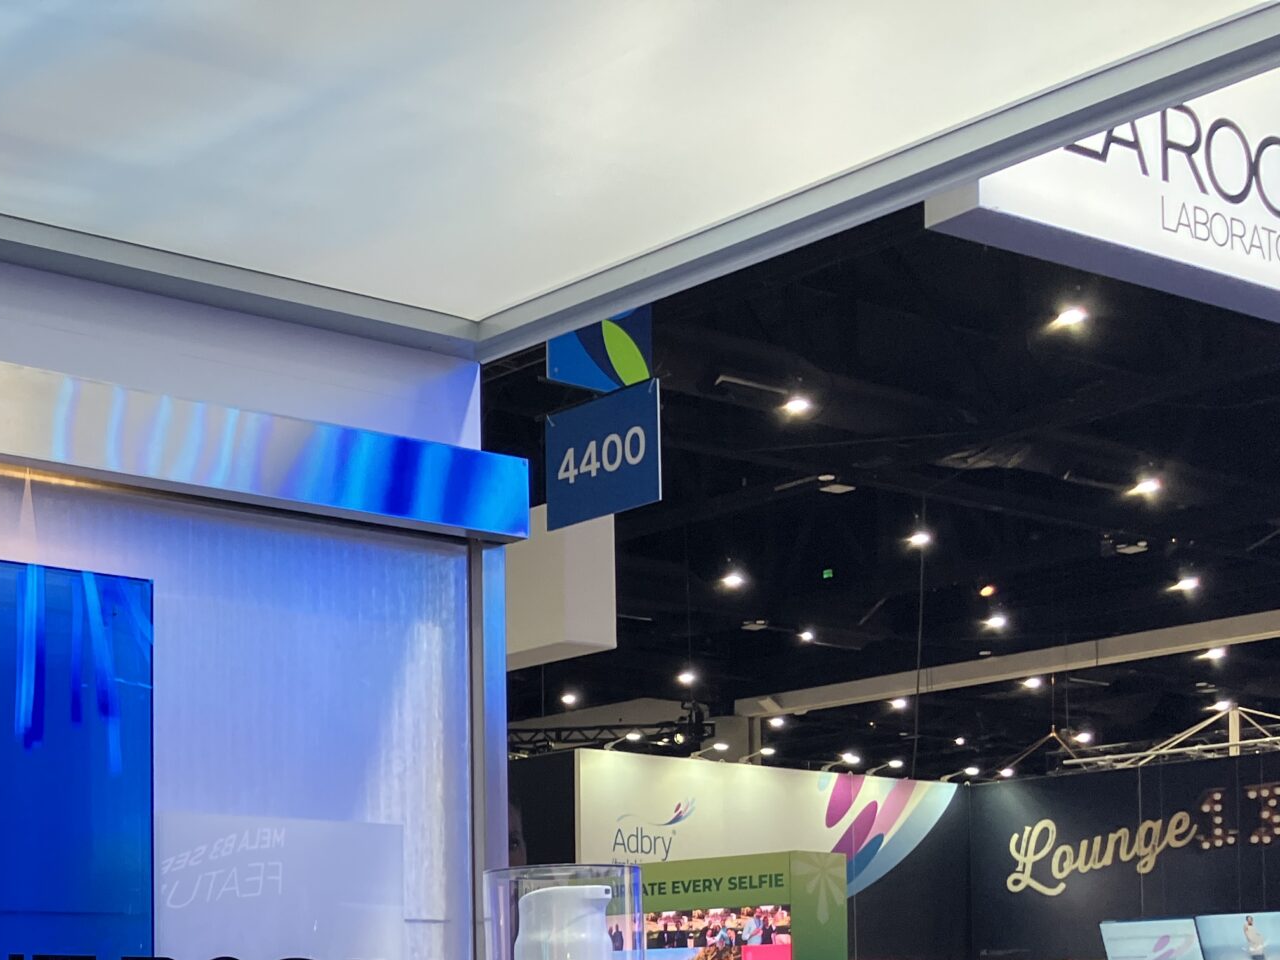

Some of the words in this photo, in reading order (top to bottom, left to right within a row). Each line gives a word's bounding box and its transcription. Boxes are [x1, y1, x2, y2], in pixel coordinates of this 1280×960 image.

[558, 426, 646, 484] 4400
[1007, 811, 1198, 896] Lounge
[672, 878, 723, 895] EVERY
[728, 873, 784, 890] SELFIE
